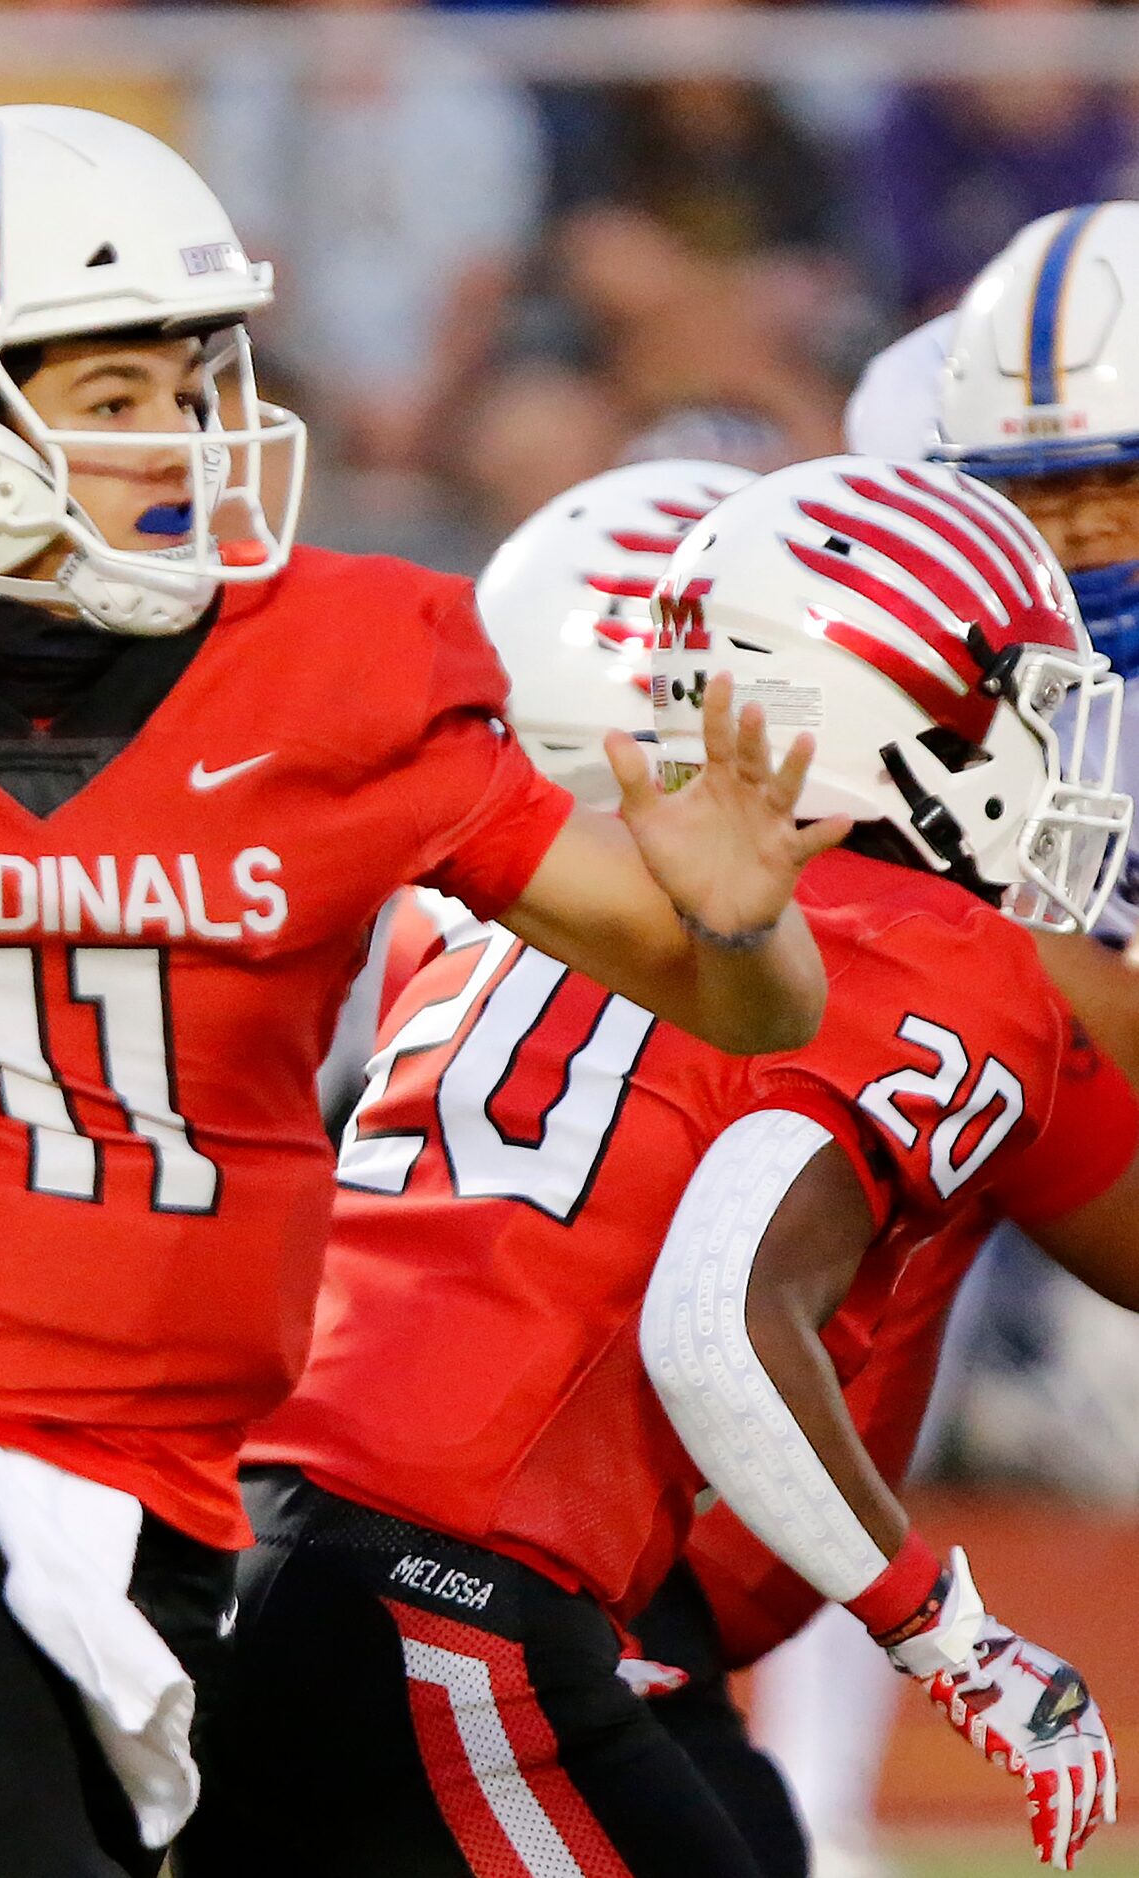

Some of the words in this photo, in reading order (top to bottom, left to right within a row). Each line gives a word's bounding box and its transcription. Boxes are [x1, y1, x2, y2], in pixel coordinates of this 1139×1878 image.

[657, 578, 714, 649] M
[857, 1011, 1025, 1200] 20
[389, 1554, 494, 1610] MELISSA
